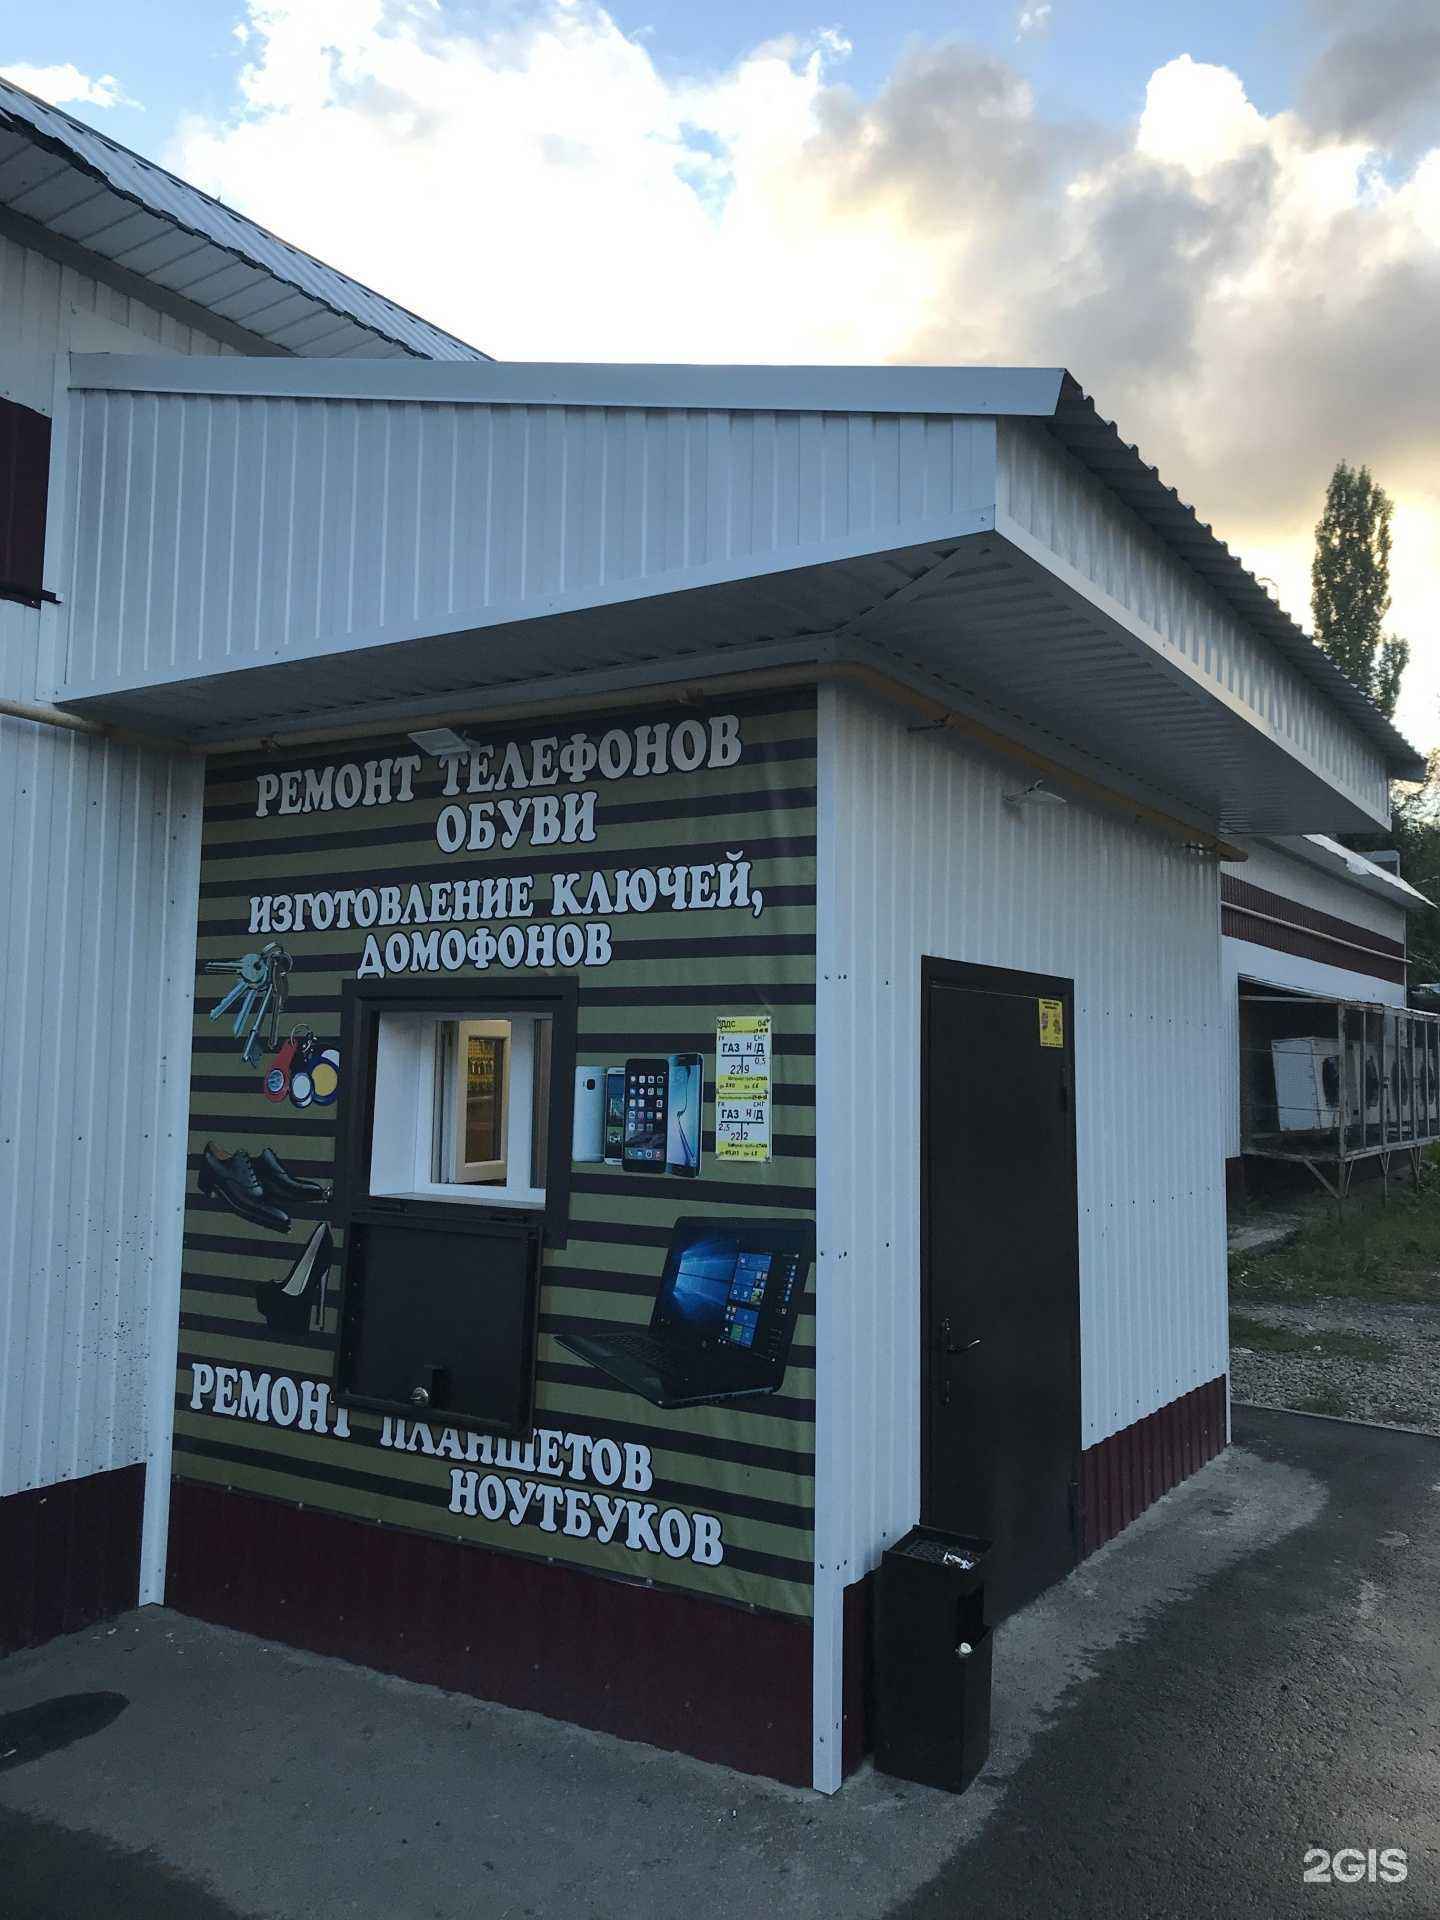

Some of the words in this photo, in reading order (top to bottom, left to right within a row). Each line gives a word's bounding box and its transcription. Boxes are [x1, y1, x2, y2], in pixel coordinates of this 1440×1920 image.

[255, 754, 421, 818] РЕМОНТ
[437, 714, 743, 796] ТЕЛЕФОНОВ
[436, 791, 598, 853] ОБУВИ
[248, 875, 534, 934] ИЗГОТОВЛЕНИЕ
[551, 850, 764, 918] КЛЮЧЕЙ,
[356, 921, 613, 979] ДОМОФОНОВ
[722, 1043, 740, 1053] ГАЗ
[721, 1109, 739, 1119] ГАЗ
[379, 1414, 654, 1494] ПЛАНШЕТОВ
[448, 1468, 725, 1567] НОУТБУКОВ
